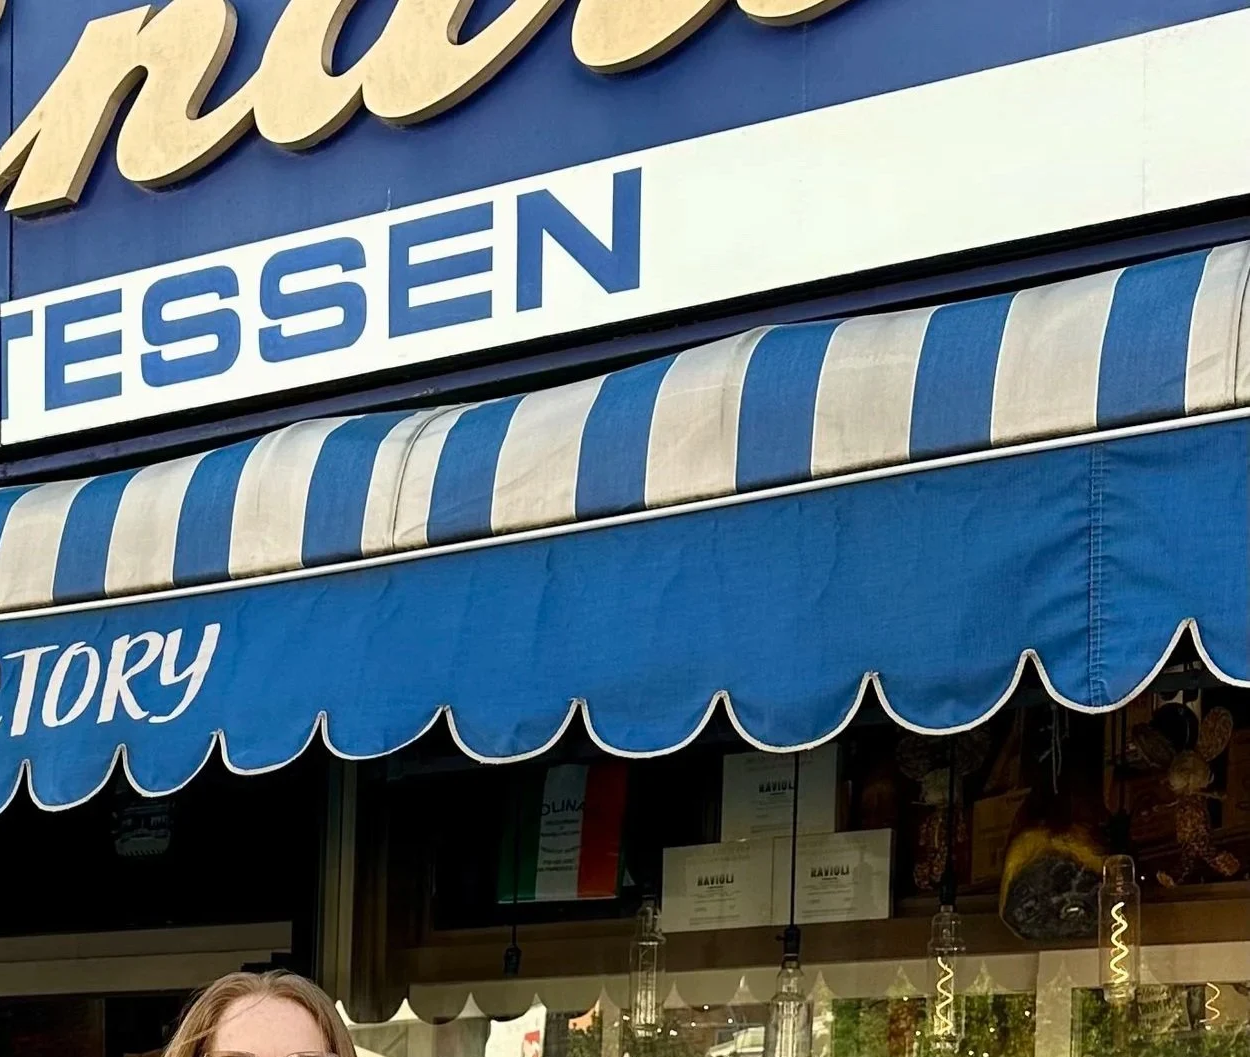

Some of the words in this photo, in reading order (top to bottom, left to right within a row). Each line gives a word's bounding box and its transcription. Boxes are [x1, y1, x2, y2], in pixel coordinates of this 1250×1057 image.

[758, 780, 794, 793] RAVIOL
[810, 865, 850, 878] RAVIOLI
[697, 874, 734, 887] RAVIOLI
